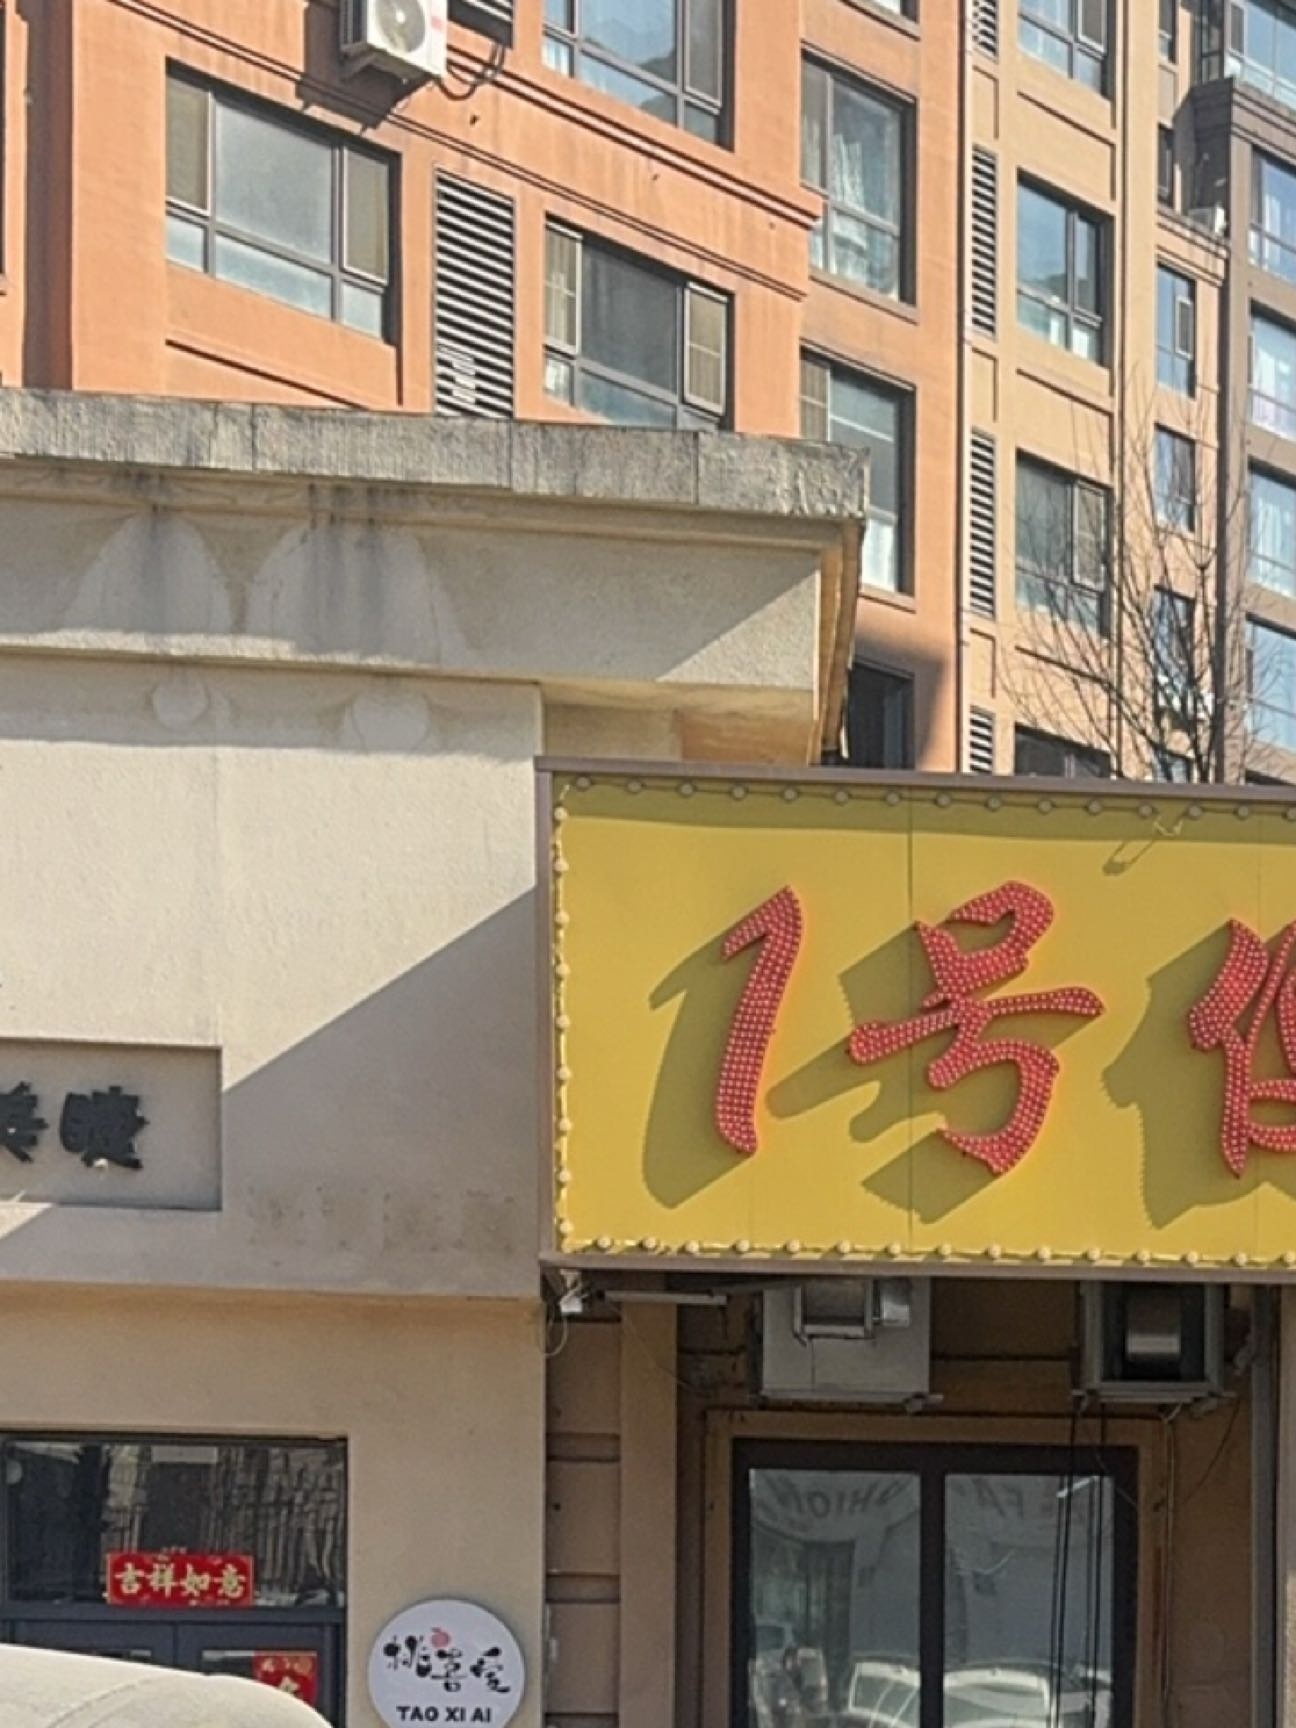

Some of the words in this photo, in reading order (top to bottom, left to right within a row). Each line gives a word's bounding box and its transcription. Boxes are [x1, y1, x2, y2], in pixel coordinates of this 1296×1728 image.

[114, 1562, 247, 1599] 吉祥如意
[396, 1706, 439, 1722] TAO
[445, 1707, 466, 1722] XI
[471, 1708, 491, 1723] AI
